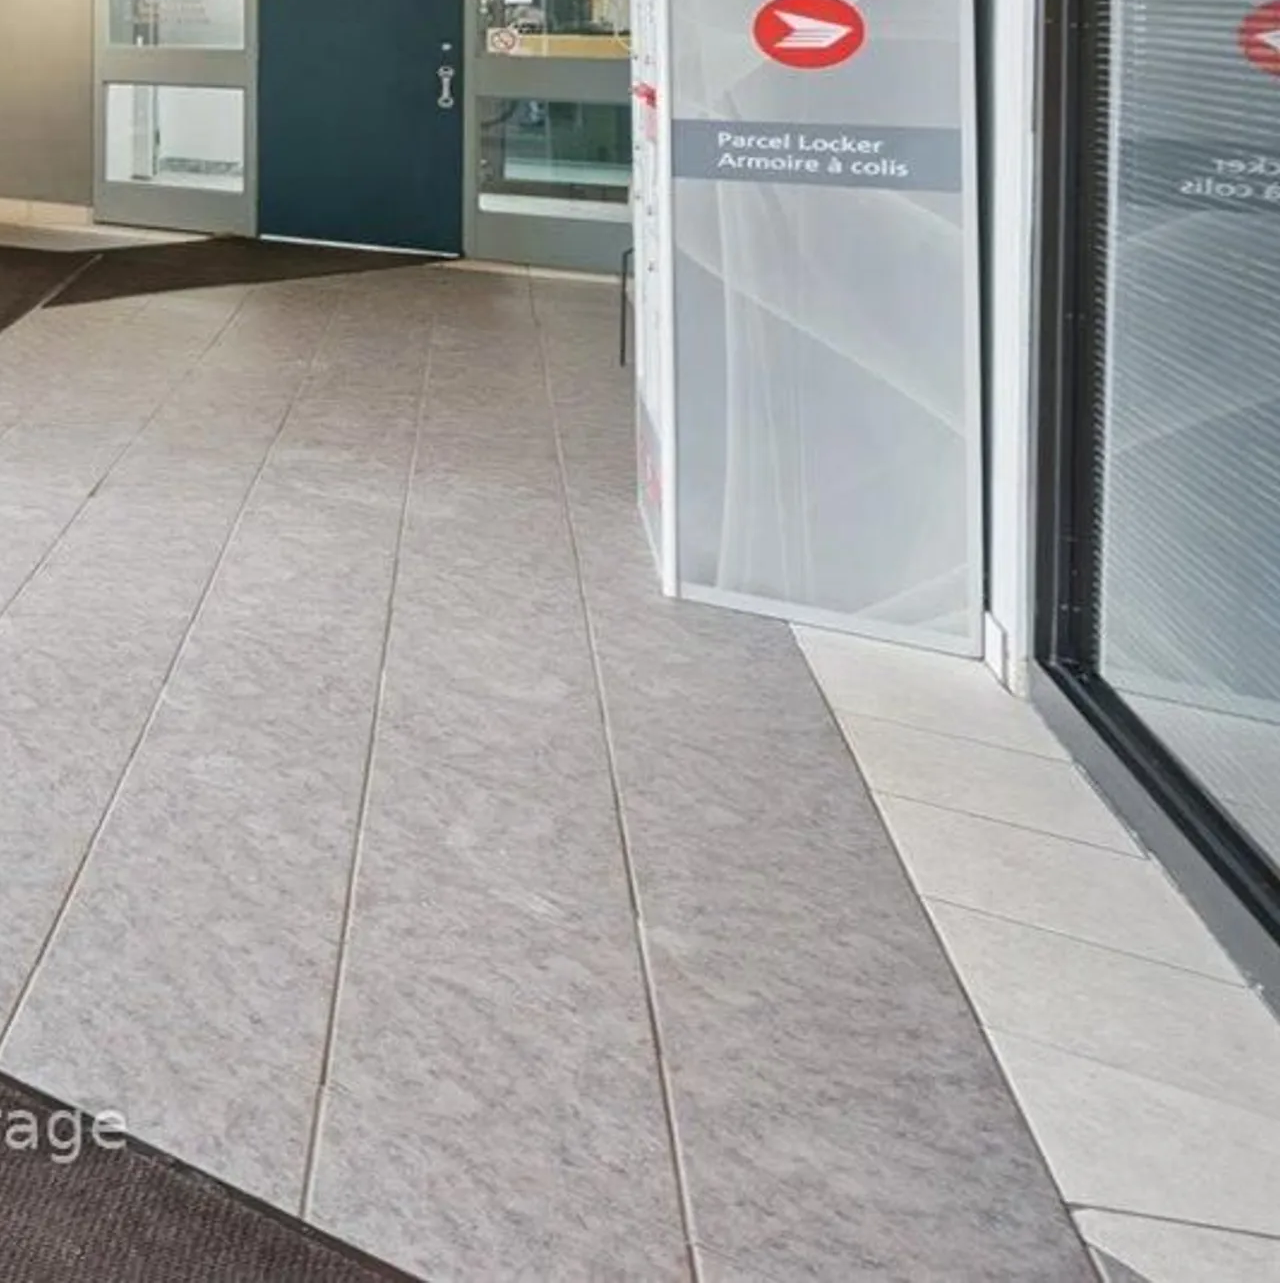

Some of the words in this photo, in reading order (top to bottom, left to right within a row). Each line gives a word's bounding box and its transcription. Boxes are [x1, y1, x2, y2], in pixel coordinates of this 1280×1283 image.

[717, 131, 790, 151] Parcel
[798, 134, 885, 154] Locker
[716, 152, 820, 173] Armoire
[827, 156, 843, 174] à
[850, 159, 910, 178] colis
